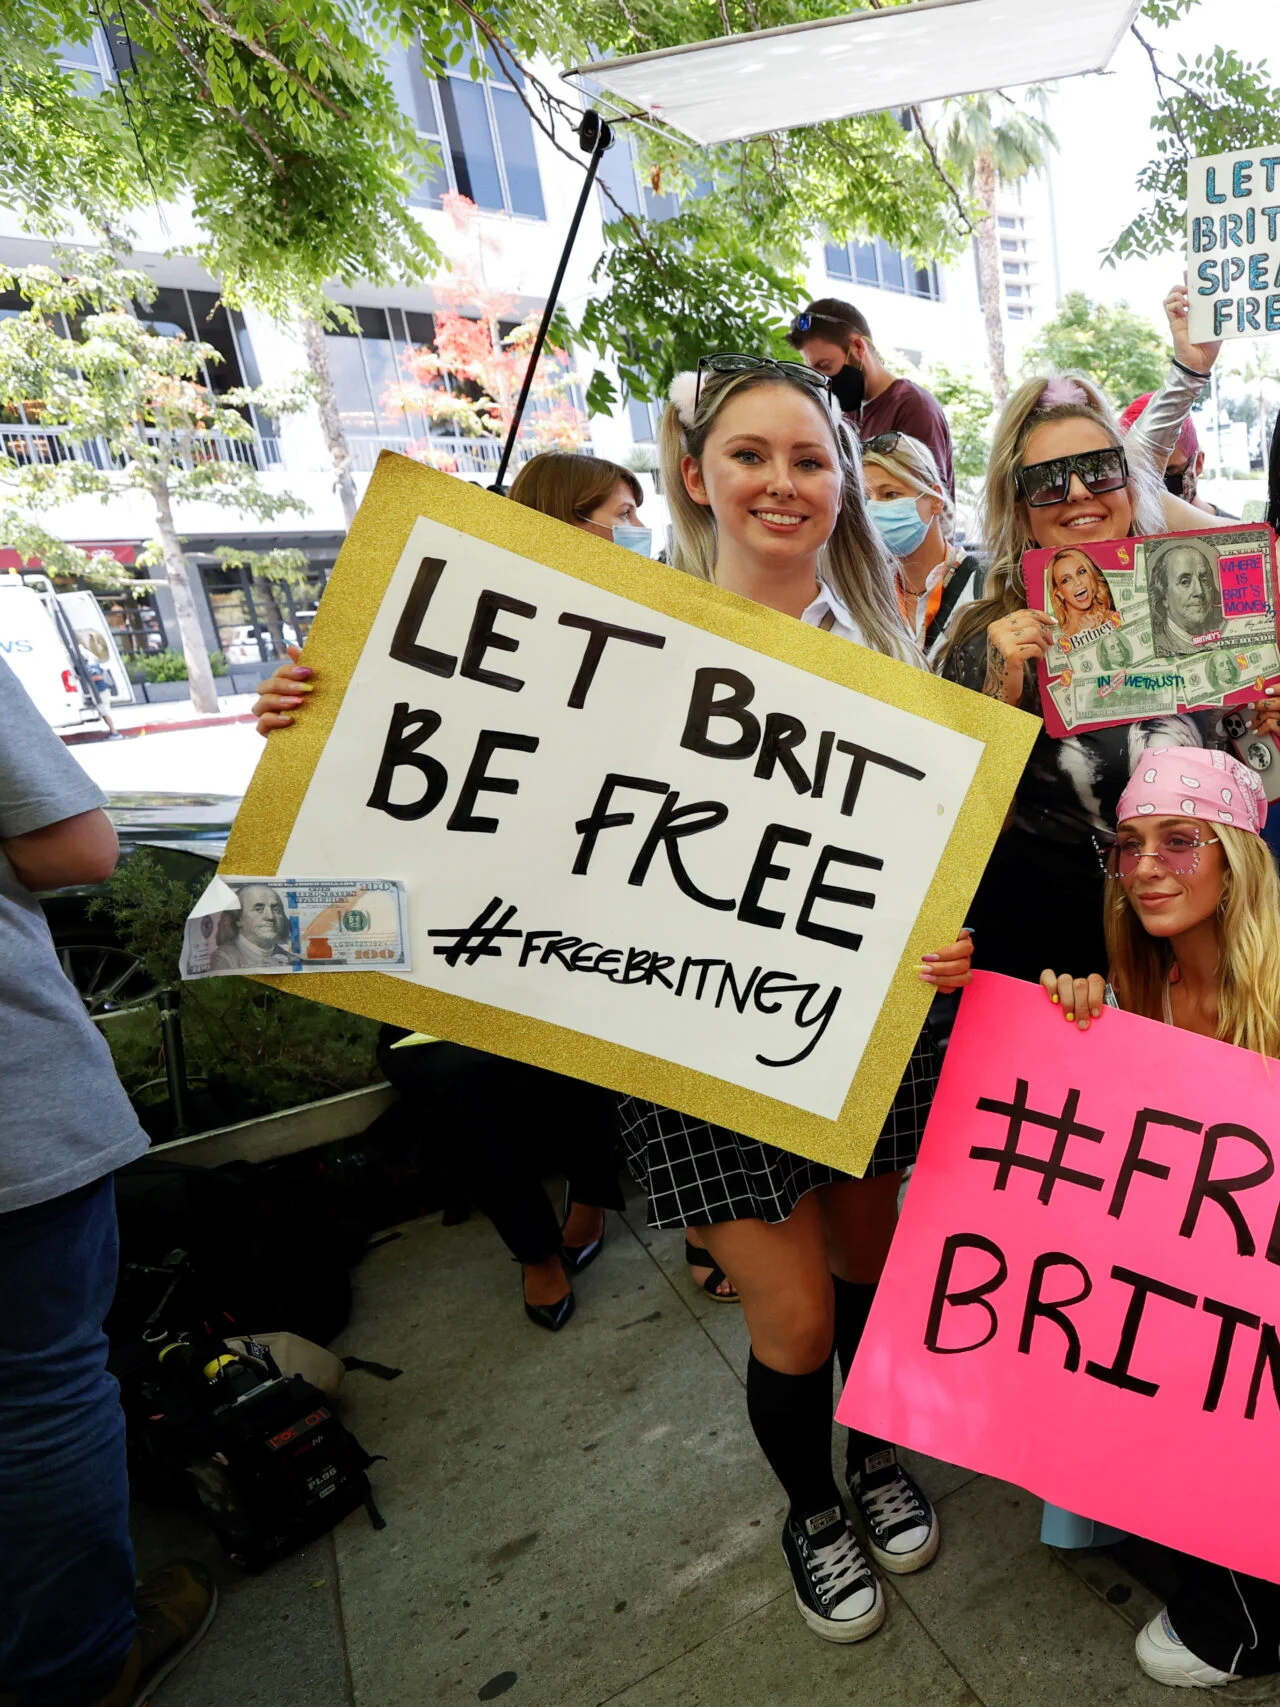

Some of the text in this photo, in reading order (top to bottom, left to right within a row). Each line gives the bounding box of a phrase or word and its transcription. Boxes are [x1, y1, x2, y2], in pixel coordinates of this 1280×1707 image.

[1221, 557, 1261, 572] WHERE
[1236, 572, 1248, 584] IS
[1069, 622, 1113, 650] Britney
[389, 556, 927, 817] LET BRIT
[1097, 675, 1110, 688] IN
[366, 701, 885, 952] BE FREE
[427, 895, 842, 1066] #FREEBRITNEY
